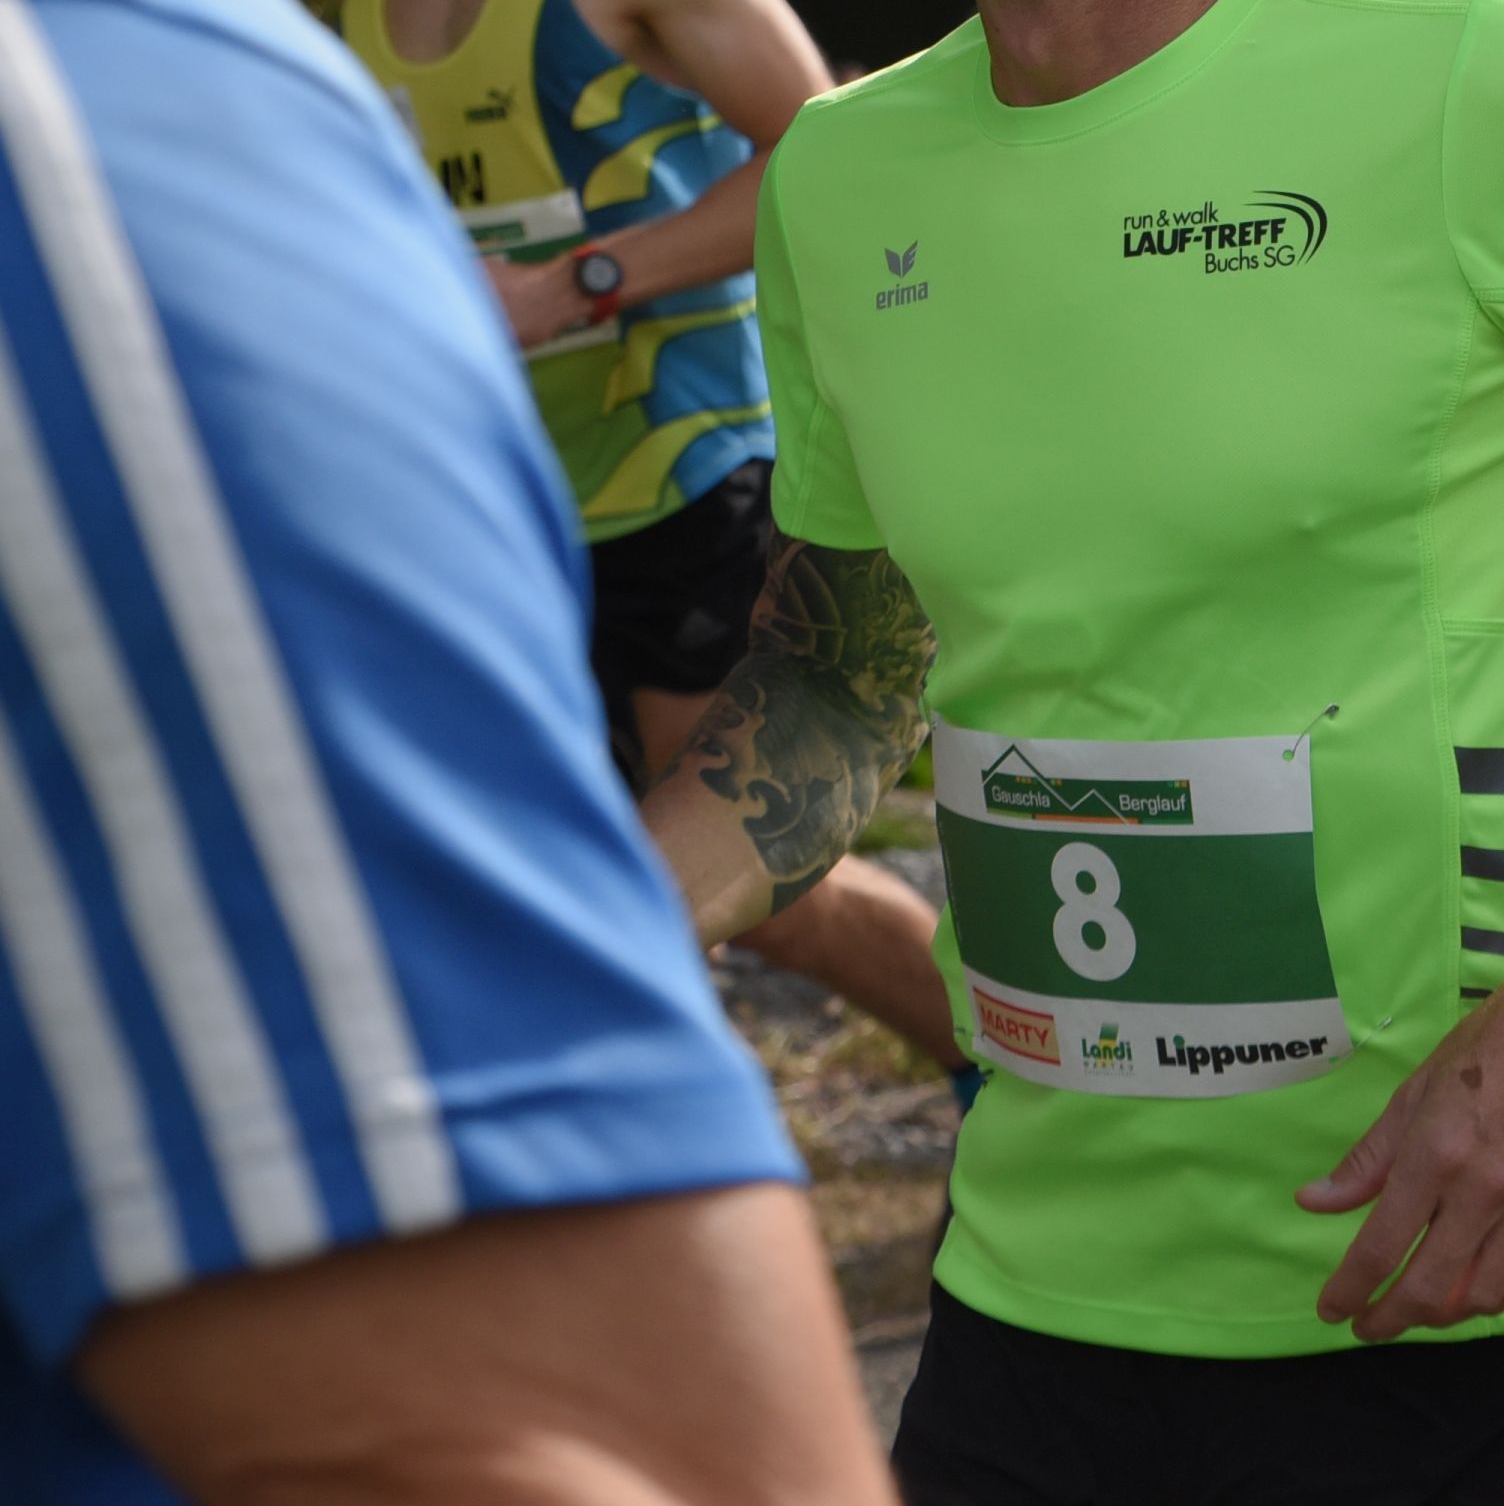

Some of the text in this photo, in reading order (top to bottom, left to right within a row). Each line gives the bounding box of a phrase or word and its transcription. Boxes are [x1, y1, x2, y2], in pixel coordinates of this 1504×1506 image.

[1124, 201, 1219, 230] run & walk
[1123, 217, 1287, 258] LAUF-TREFF
[1205, 245, 1296, 274] Buchs SG
[876, 281, 928, 310] erima
[991, 785, 1186, 816] Gauschla Berglauf
[1051, 841, 1136, 982] 8
[979, 1004, 1050, 1049] MARTY
[1081, 1037, 1133, 1062] Landi
[1156, 1034, 1328, 1076] Lippuner
